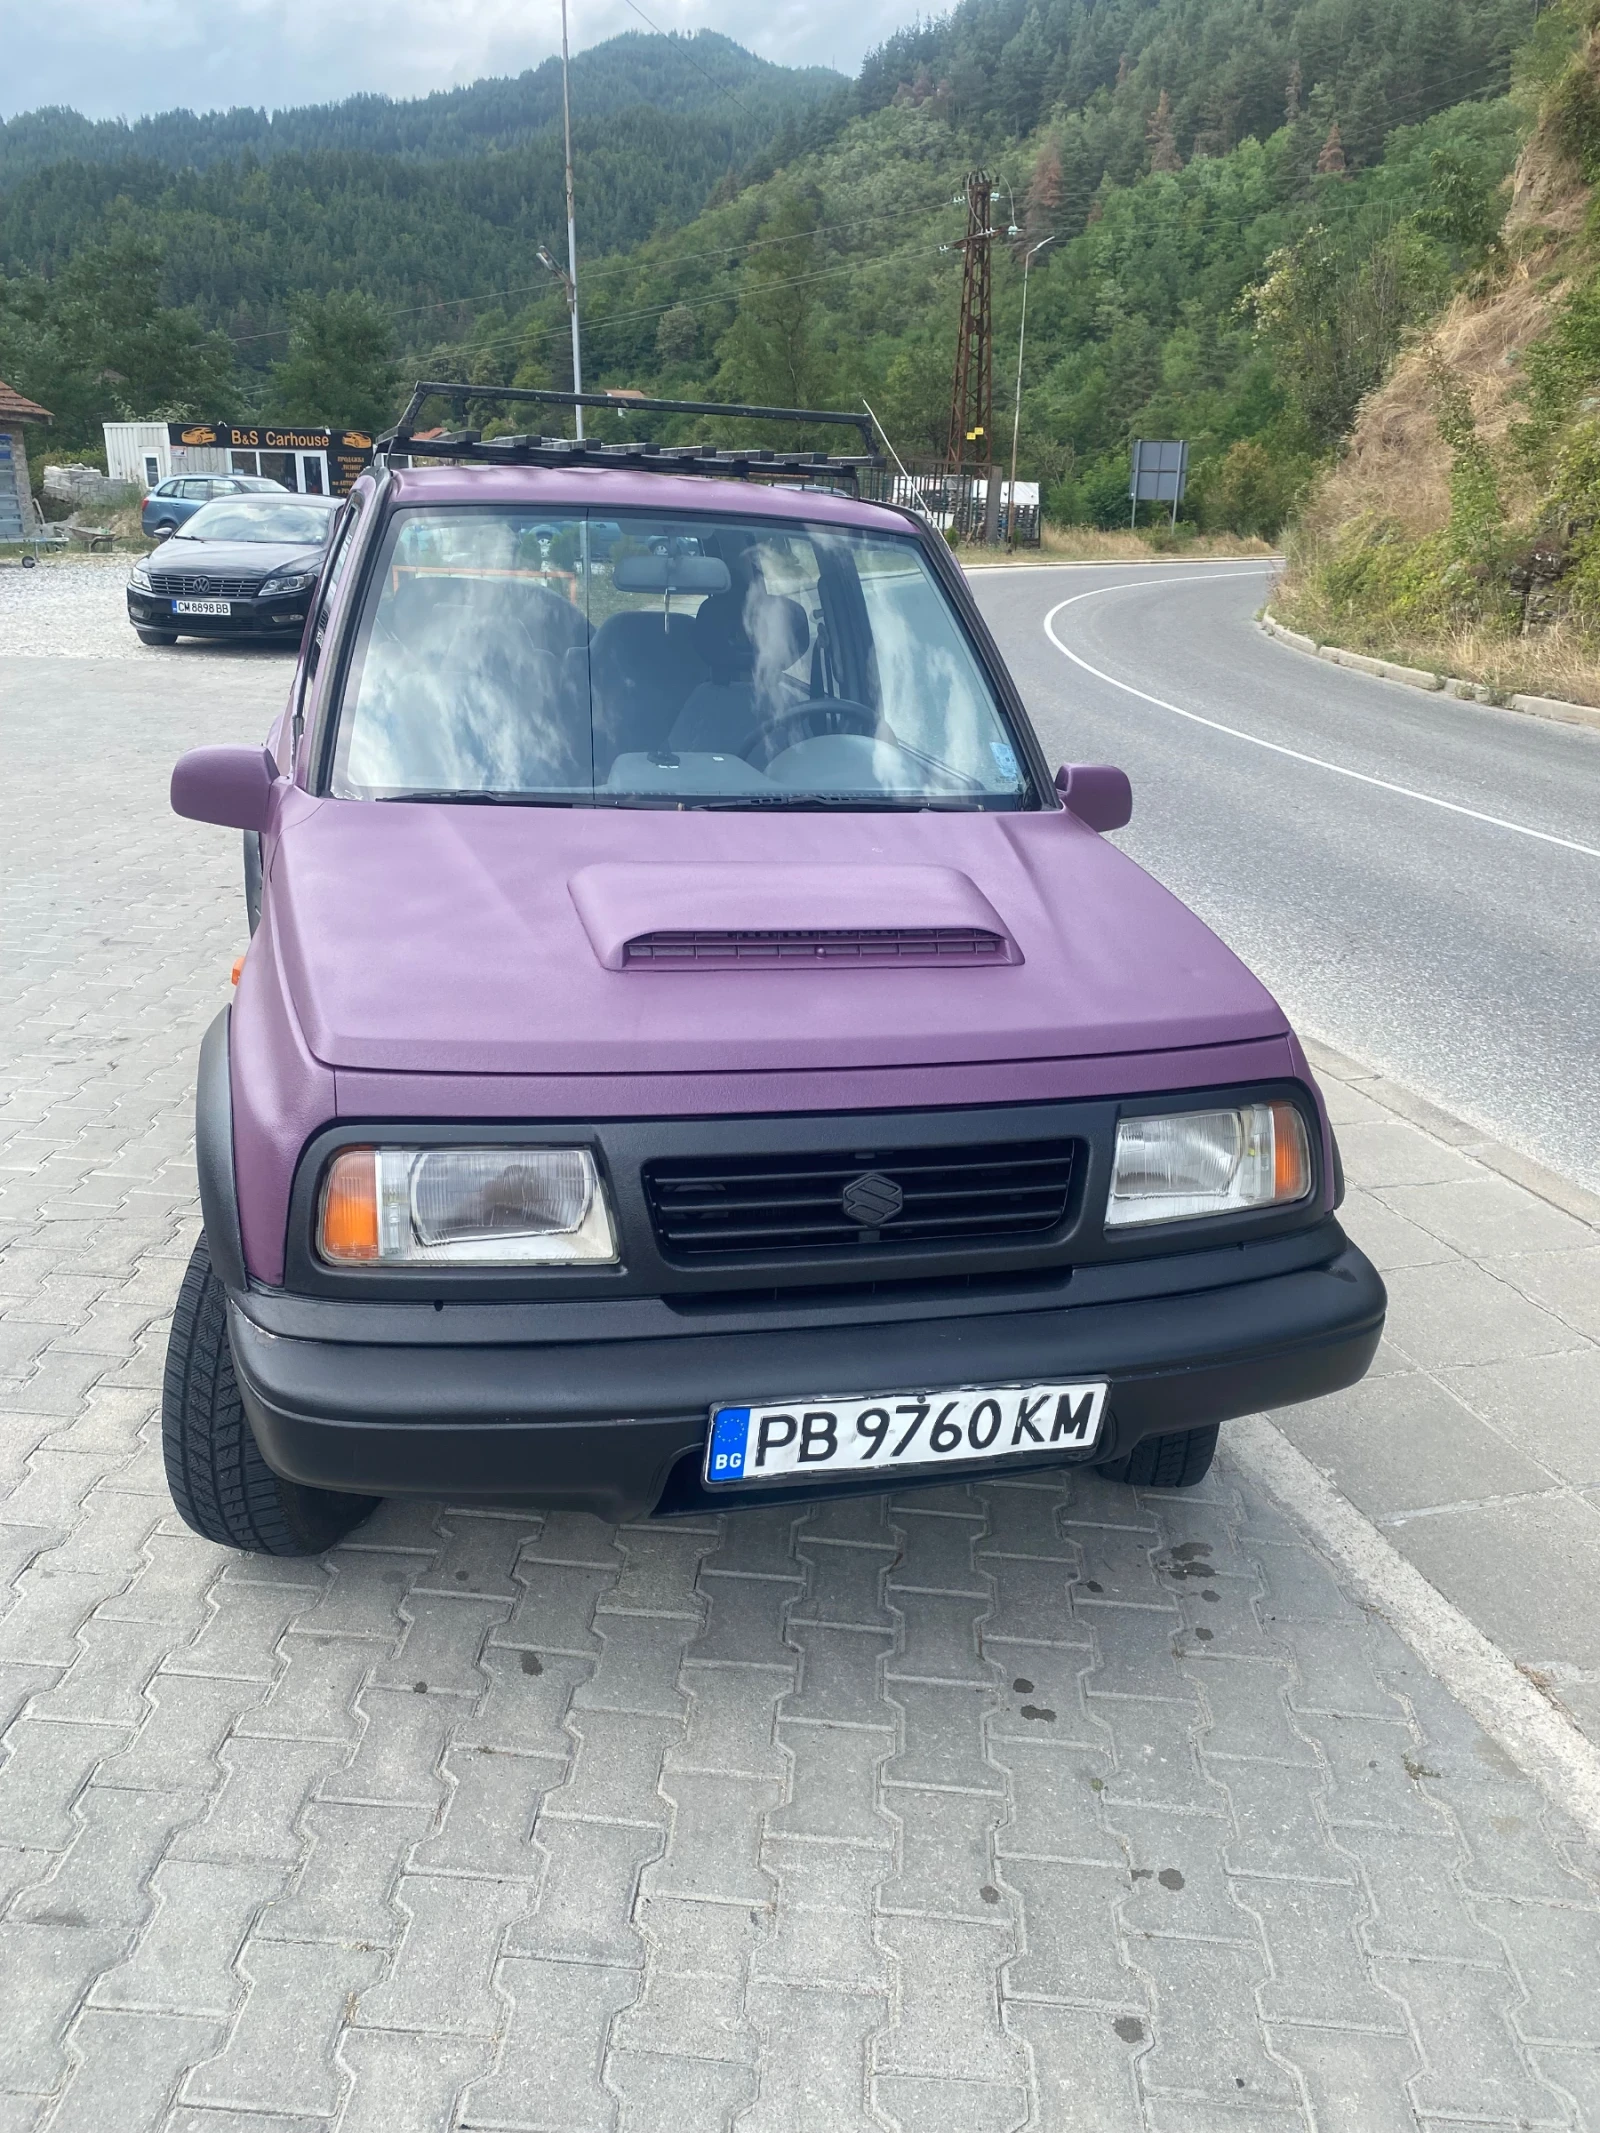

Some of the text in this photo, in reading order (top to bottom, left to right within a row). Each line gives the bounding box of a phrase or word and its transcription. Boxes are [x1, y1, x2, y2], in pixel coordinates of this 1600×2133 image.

[231, 429, 330, 447] B&S Carhouse
[178, 602, 229, 614] CM 8898 BB
[755, 1391, 1096, 1467] PB 9760 KM
[715, 1453, 742, 1470] BG
